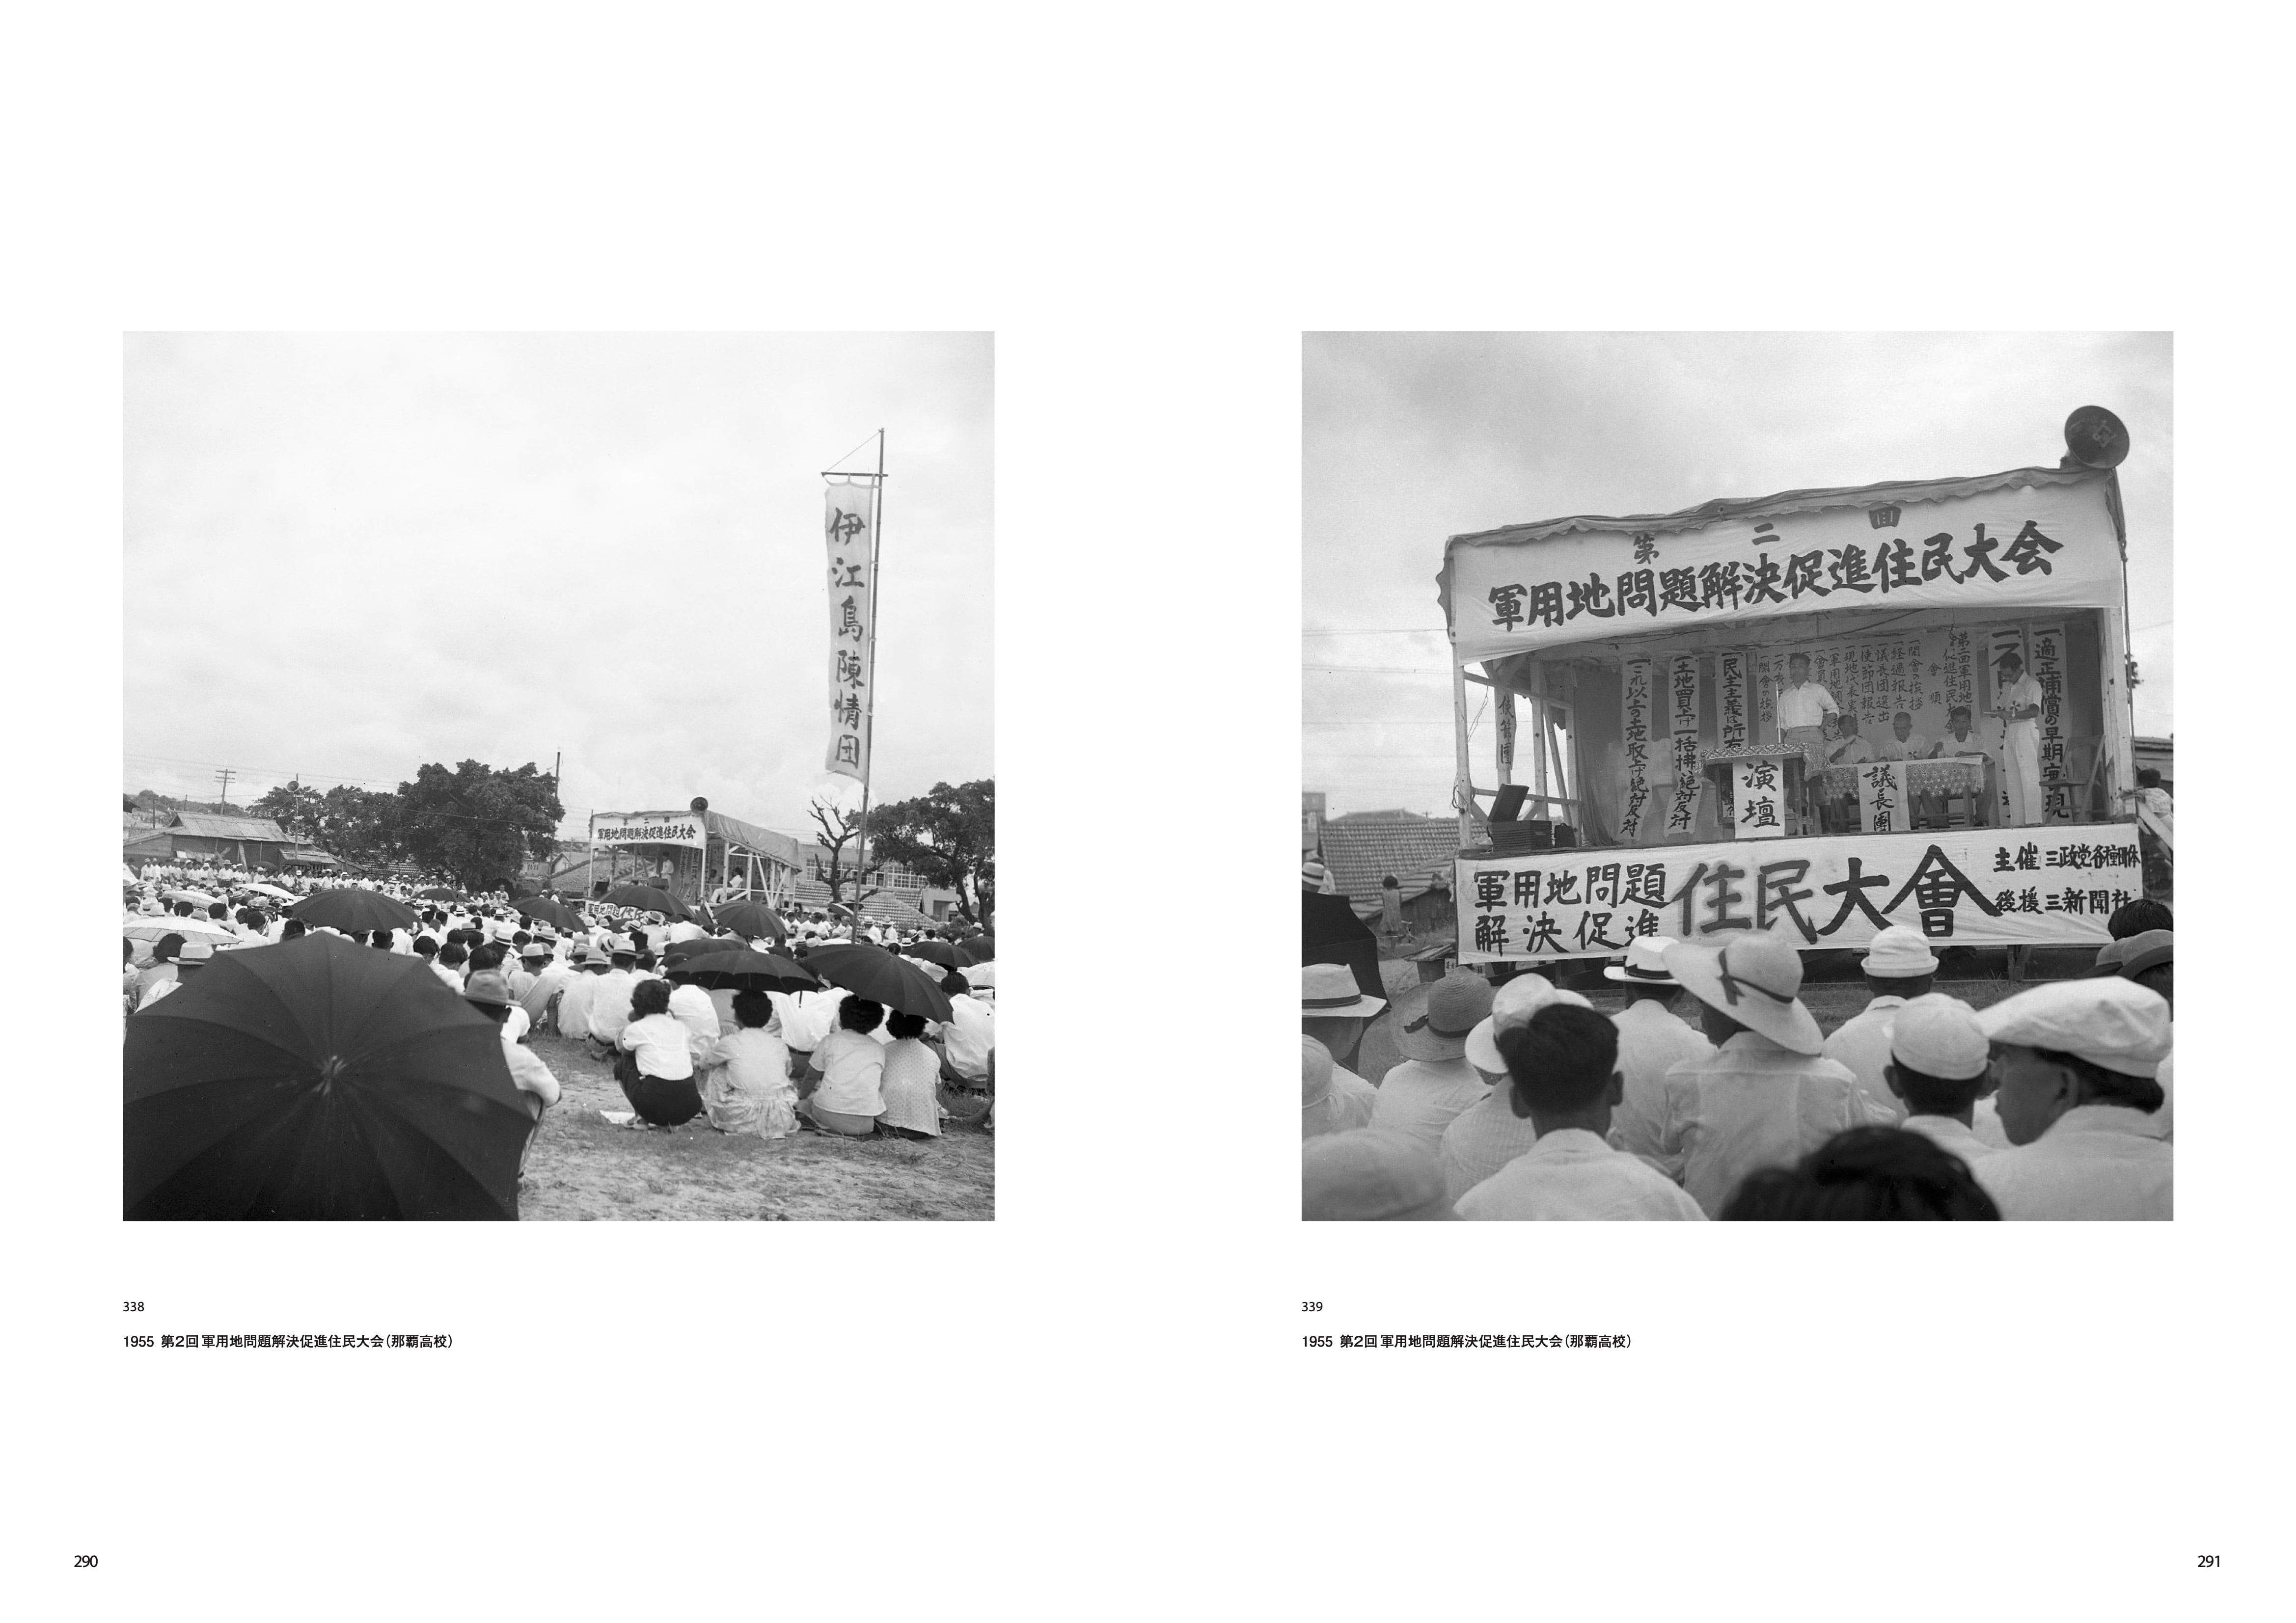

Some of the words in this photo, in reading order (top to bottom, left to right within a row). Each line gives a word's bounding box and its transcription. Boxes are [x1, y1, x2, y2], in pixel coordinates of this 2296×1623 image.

[1488, 519, 2064, 632] 軍用地問題解決促進住民大会
[828, 507, 867, 769] 伊江島陳情団
[1741, 760, 1780, 828] 演壇
[1474, 863, 1671, 912] 軍用地問題
[1475, 909, 1660, 957] 解決促進
